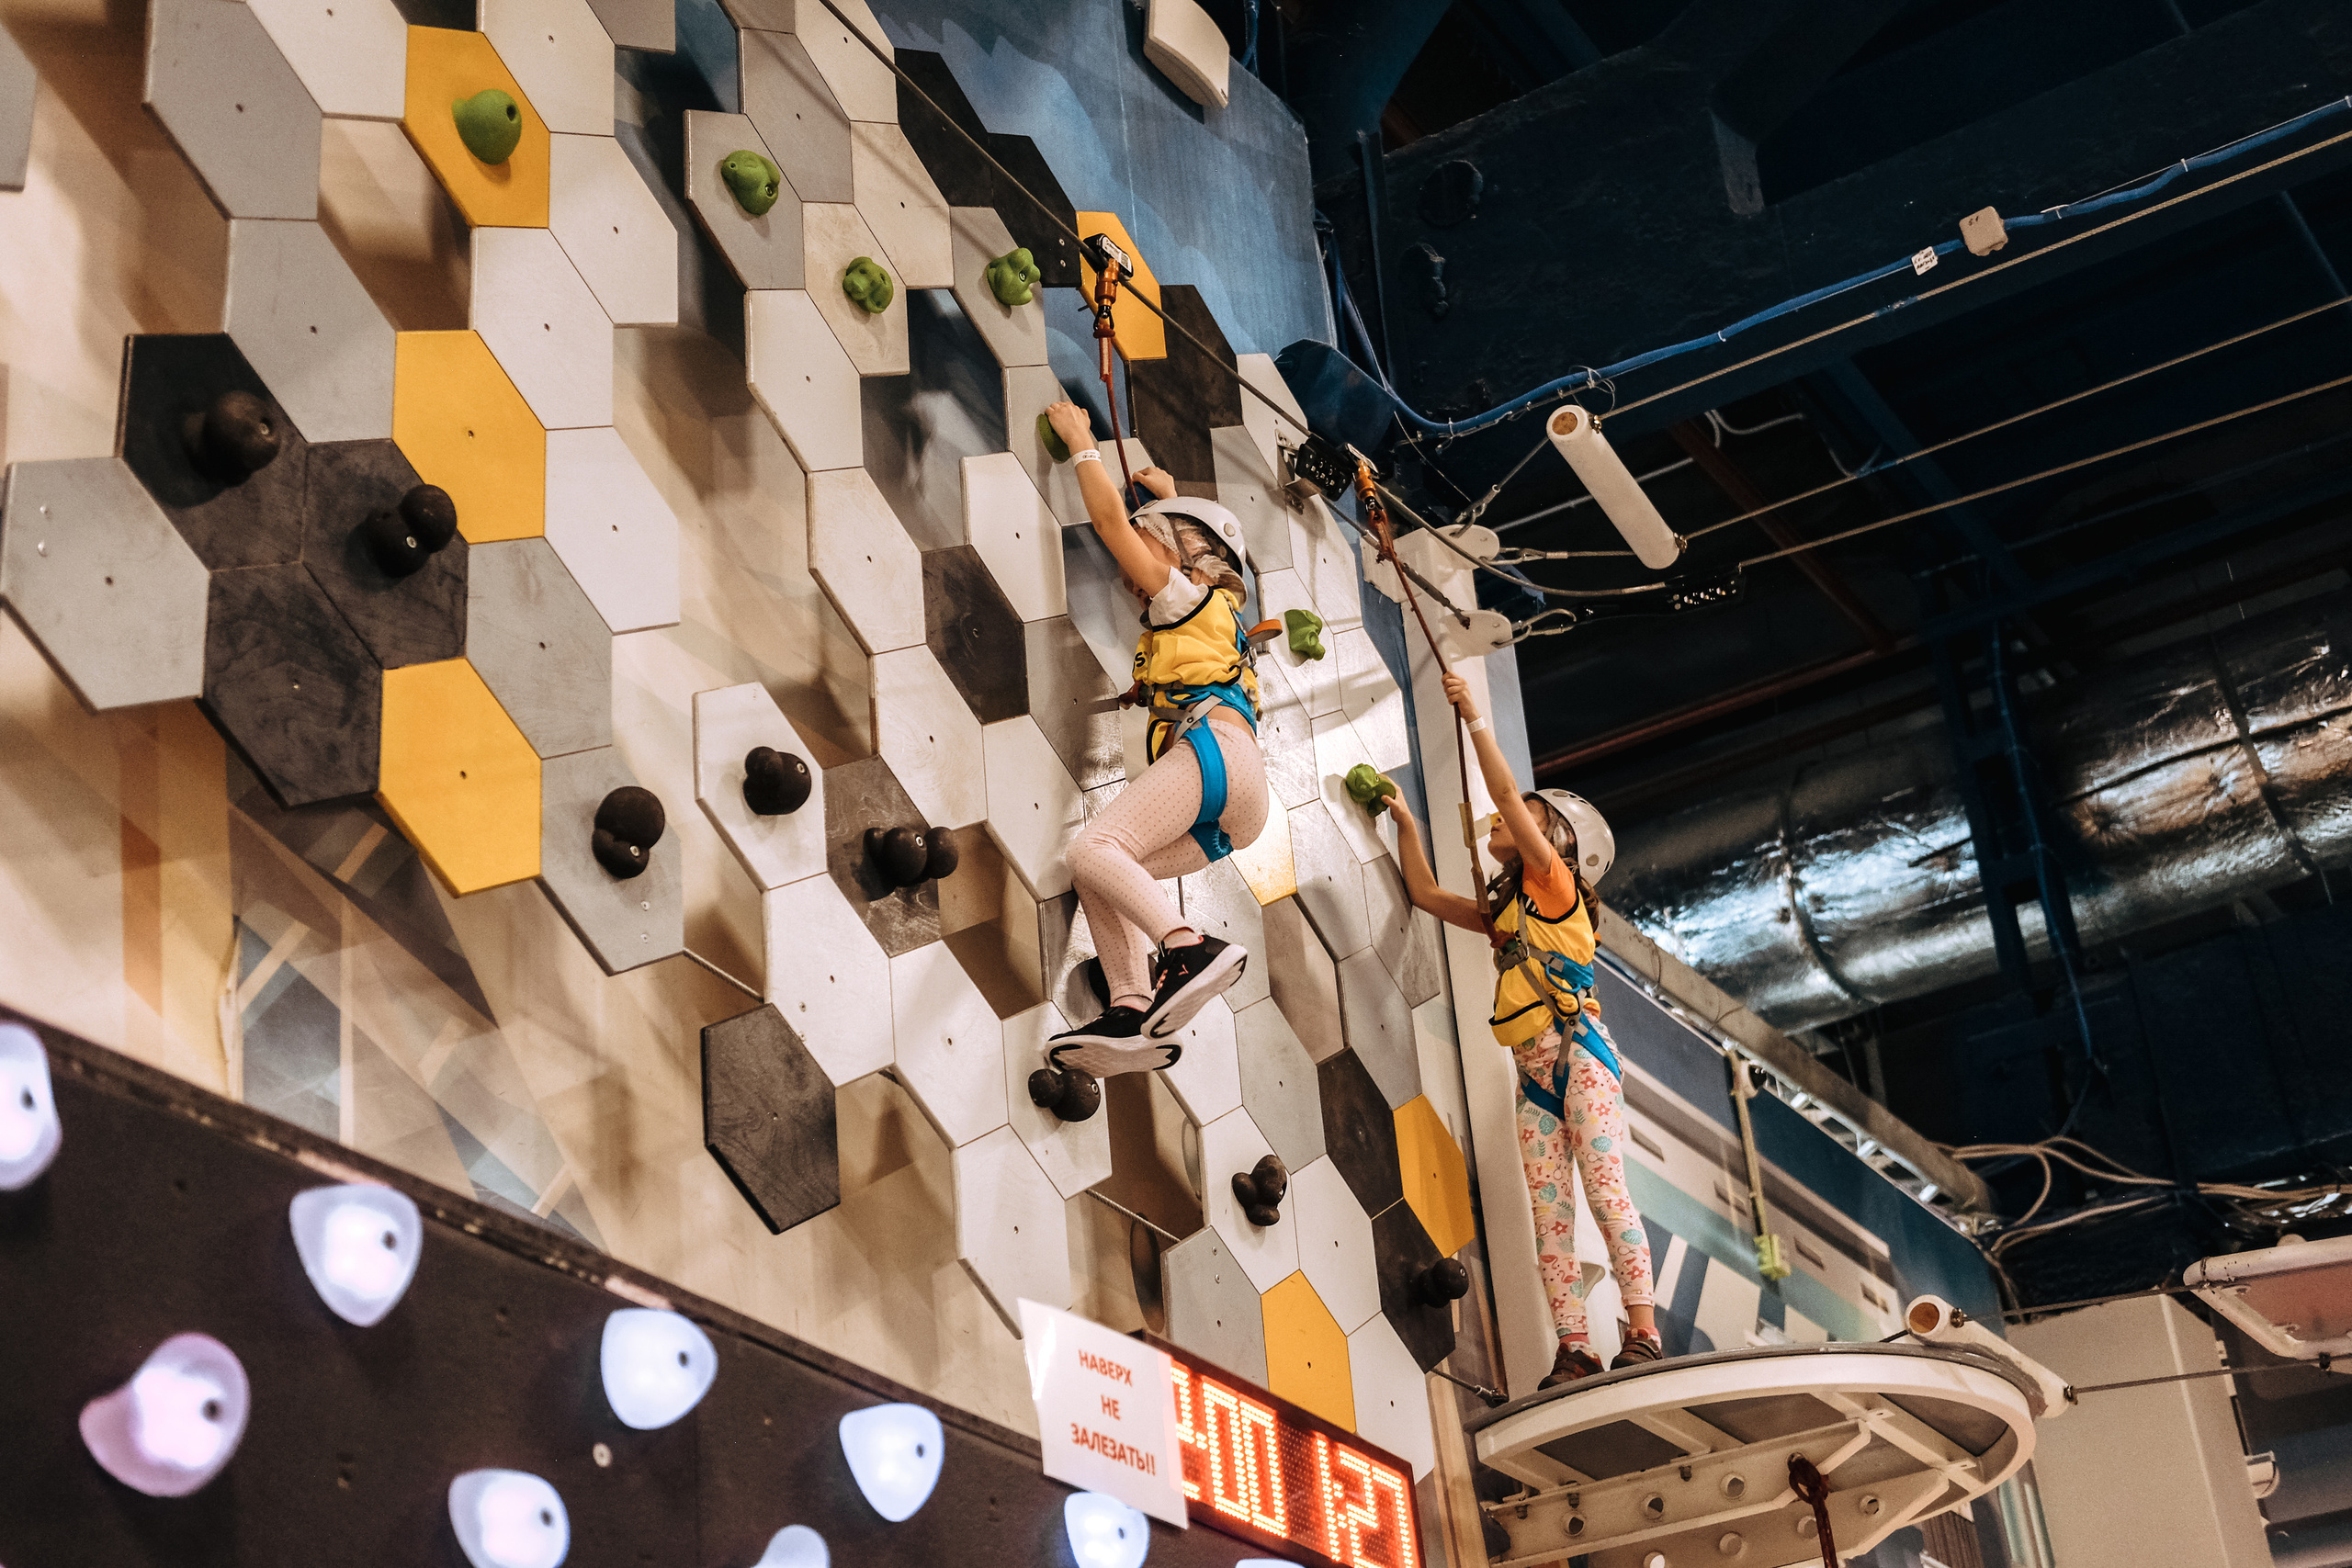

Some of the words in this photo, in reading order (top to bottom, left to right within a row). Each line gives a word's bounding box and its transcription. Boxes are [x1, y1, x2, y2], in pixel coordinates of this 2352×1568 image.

[1079, 1349, 1133, 1388] НАВЕРХ
[1101, 1393, 1121, 1421] НЕ
[1070, 1422, 1156, 1476] ЗАЛЕЗАТЬ!!
